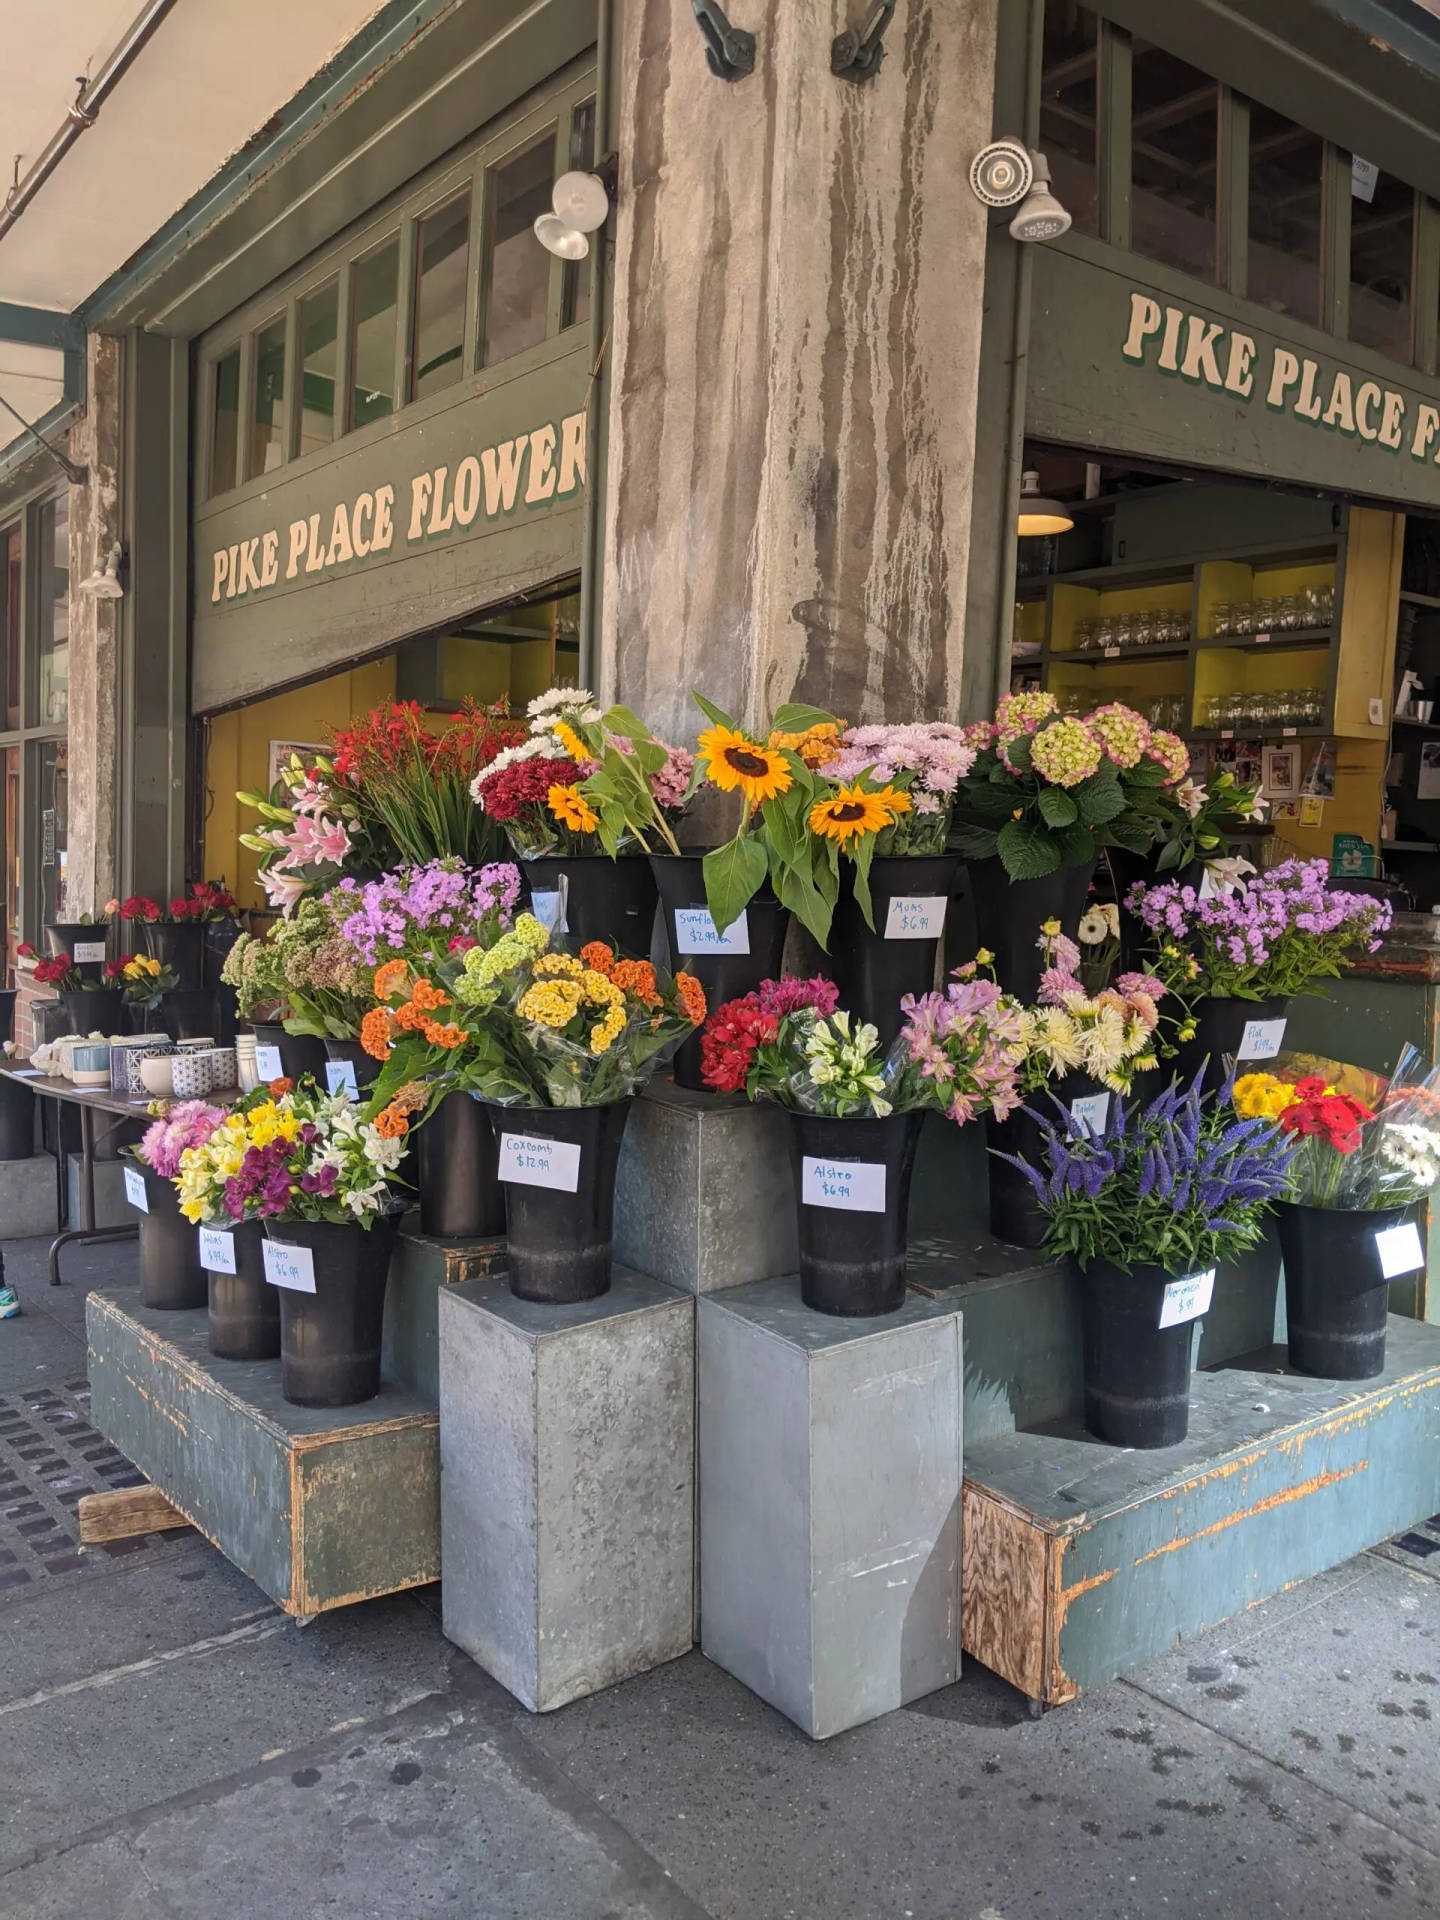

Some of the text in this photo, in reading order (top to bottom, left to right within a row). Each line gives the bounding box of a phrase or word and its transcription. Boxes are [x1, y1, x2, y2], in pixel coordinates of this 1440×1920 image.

[1122, 292, 1440, 465] PIKE PLACE F
[211, 411, 587, 602] PIKE PLACE FLOWER
[679, 912, 716, 925] Sunflo
[516, 1154, 550, 1172] $12.99
[821, 1182, 850, 1198] $6.99
